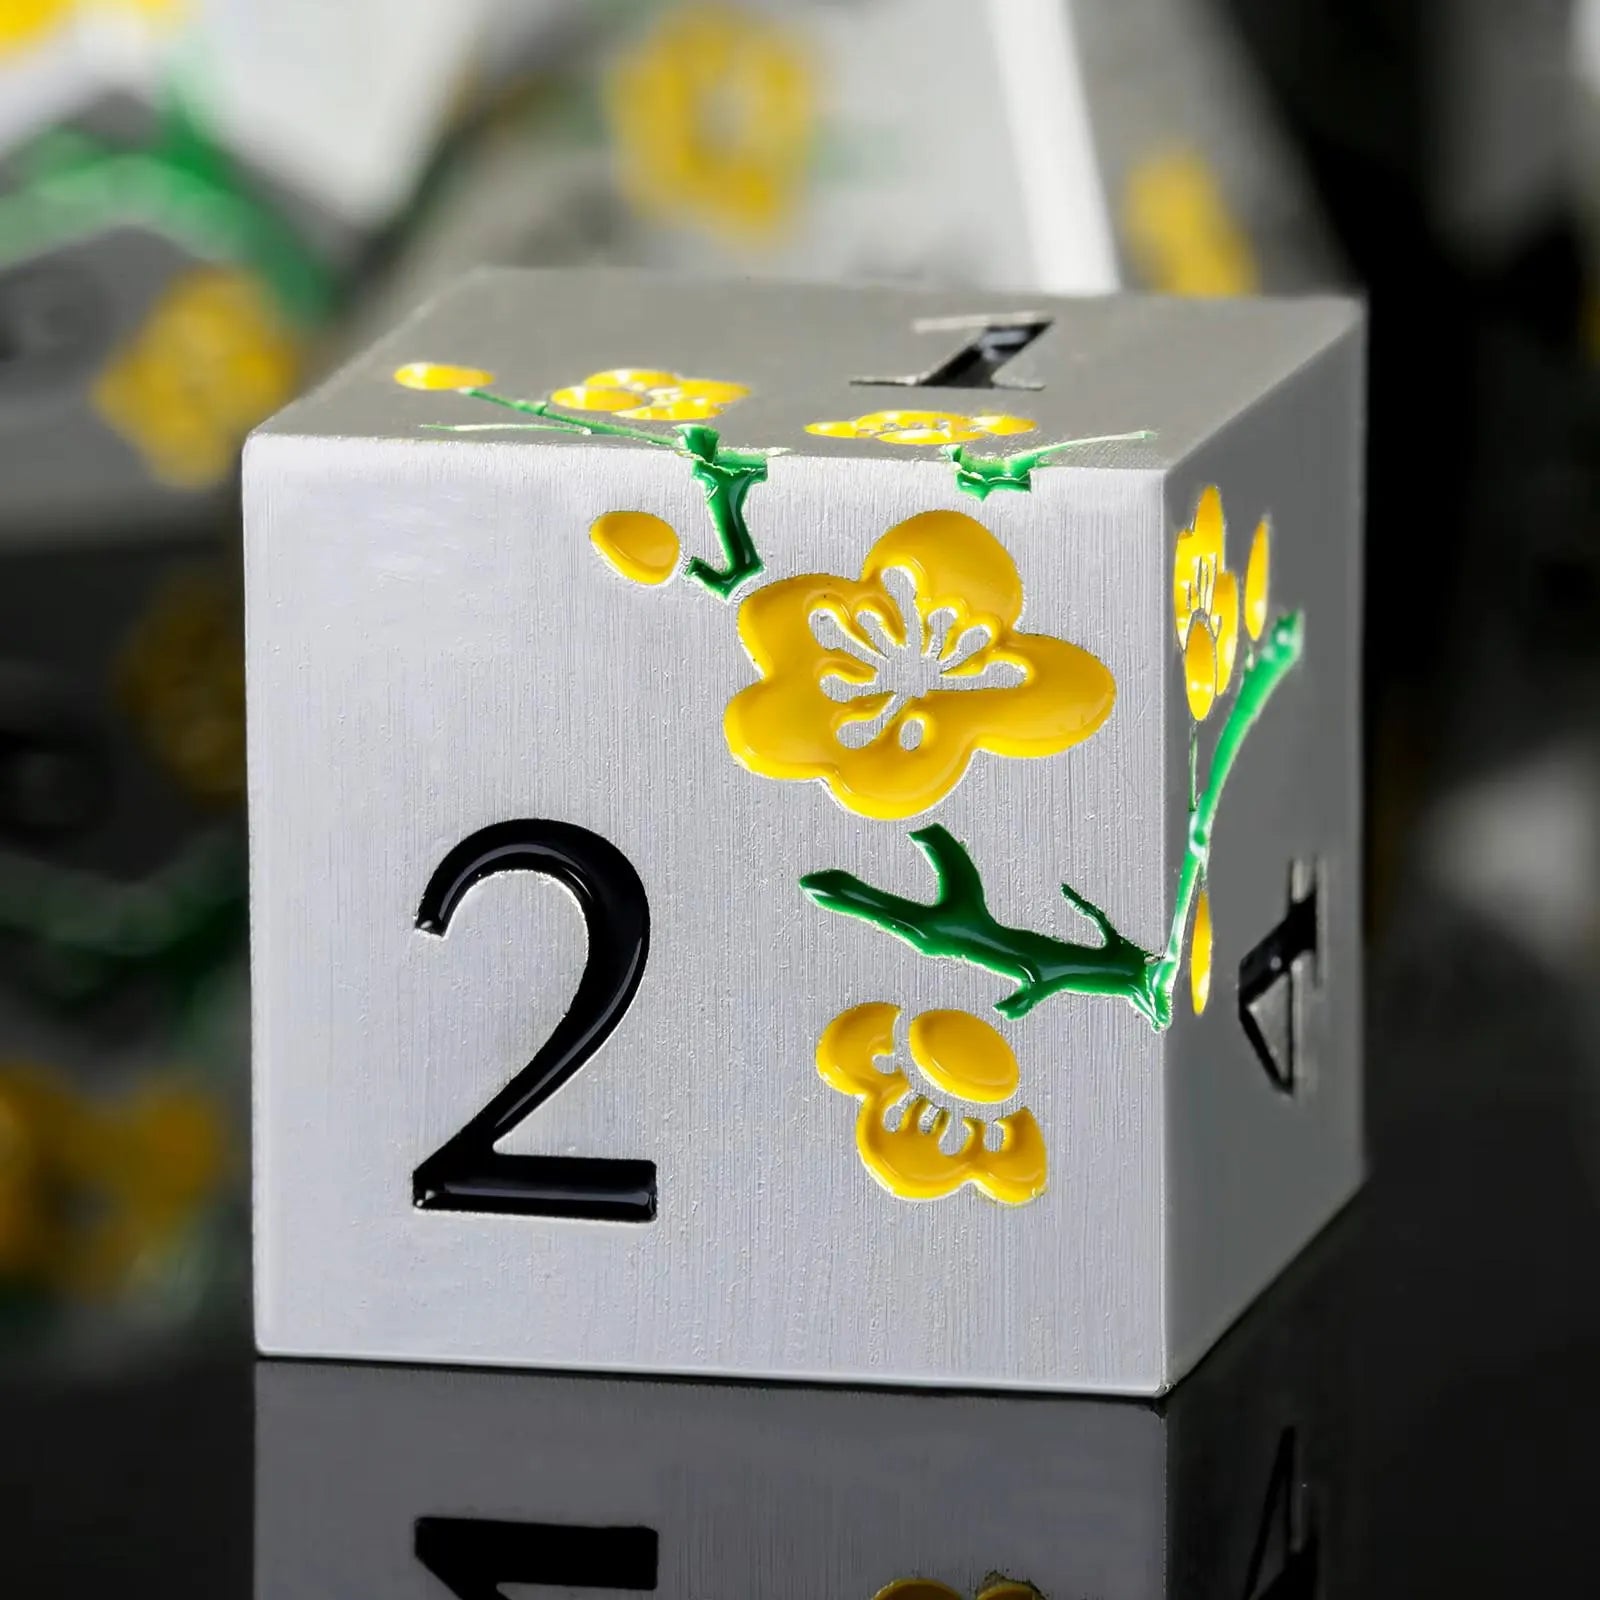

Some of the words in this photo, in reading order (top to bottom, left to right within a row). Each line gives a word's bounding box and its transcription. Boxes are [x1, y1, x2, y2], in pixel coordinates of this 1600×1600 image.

[849, 312, 1054, 391] 1
[412, 818, 657, 1221] 2
[1238, 858, 1320, 1096] 4
